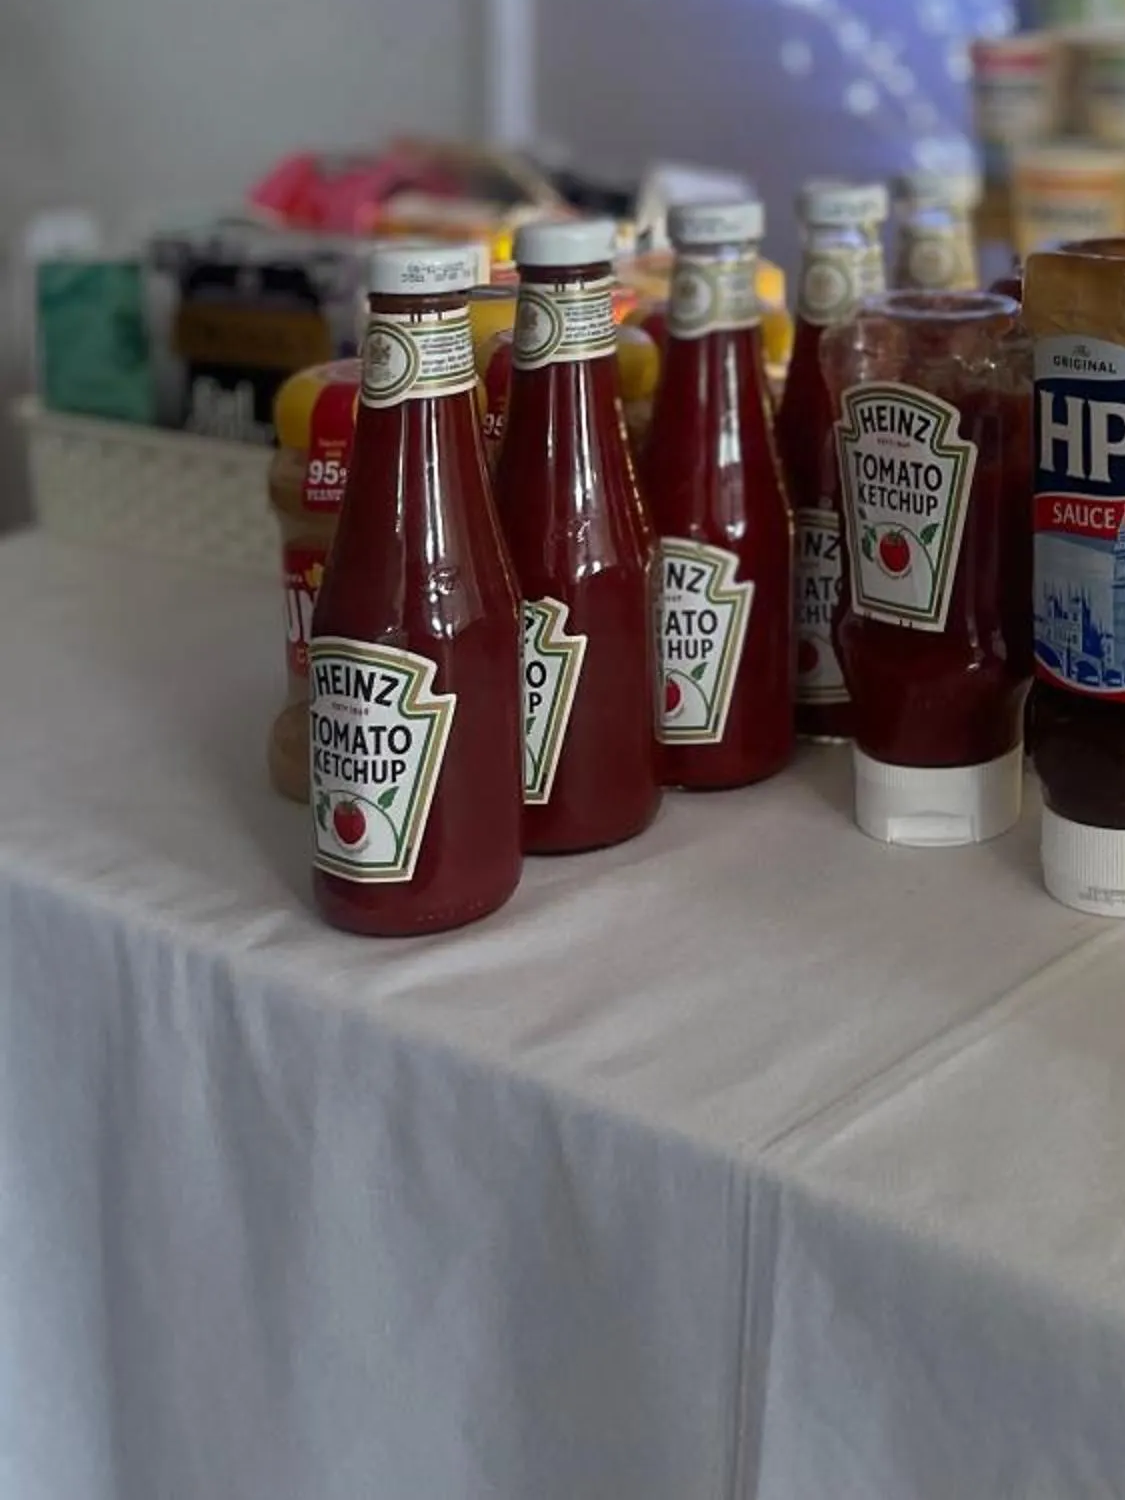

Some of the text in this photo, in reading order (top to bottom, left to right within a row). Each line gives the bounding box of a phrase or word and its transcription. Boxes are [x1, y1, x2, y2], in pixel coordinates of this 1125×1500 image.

[1053, 354, 1117, 375] ORIGINAL
[858, 404, 932, 444] HEINZ
[852, 451, 943, 492] TOMATO
[857, 484, 939, 517] KETCHUP
[1052, 503, 1117, 529] SAUCE
[665, 562, 706, 594] NZ
[664, 609, 718, 637] ATO
[666, 638, 714, 661] HUP
[315, 664, 399, 707] HEINZ
[311, 712, 413, 755] TOMATO
[313, 746, 407, 785] KETCHUP
